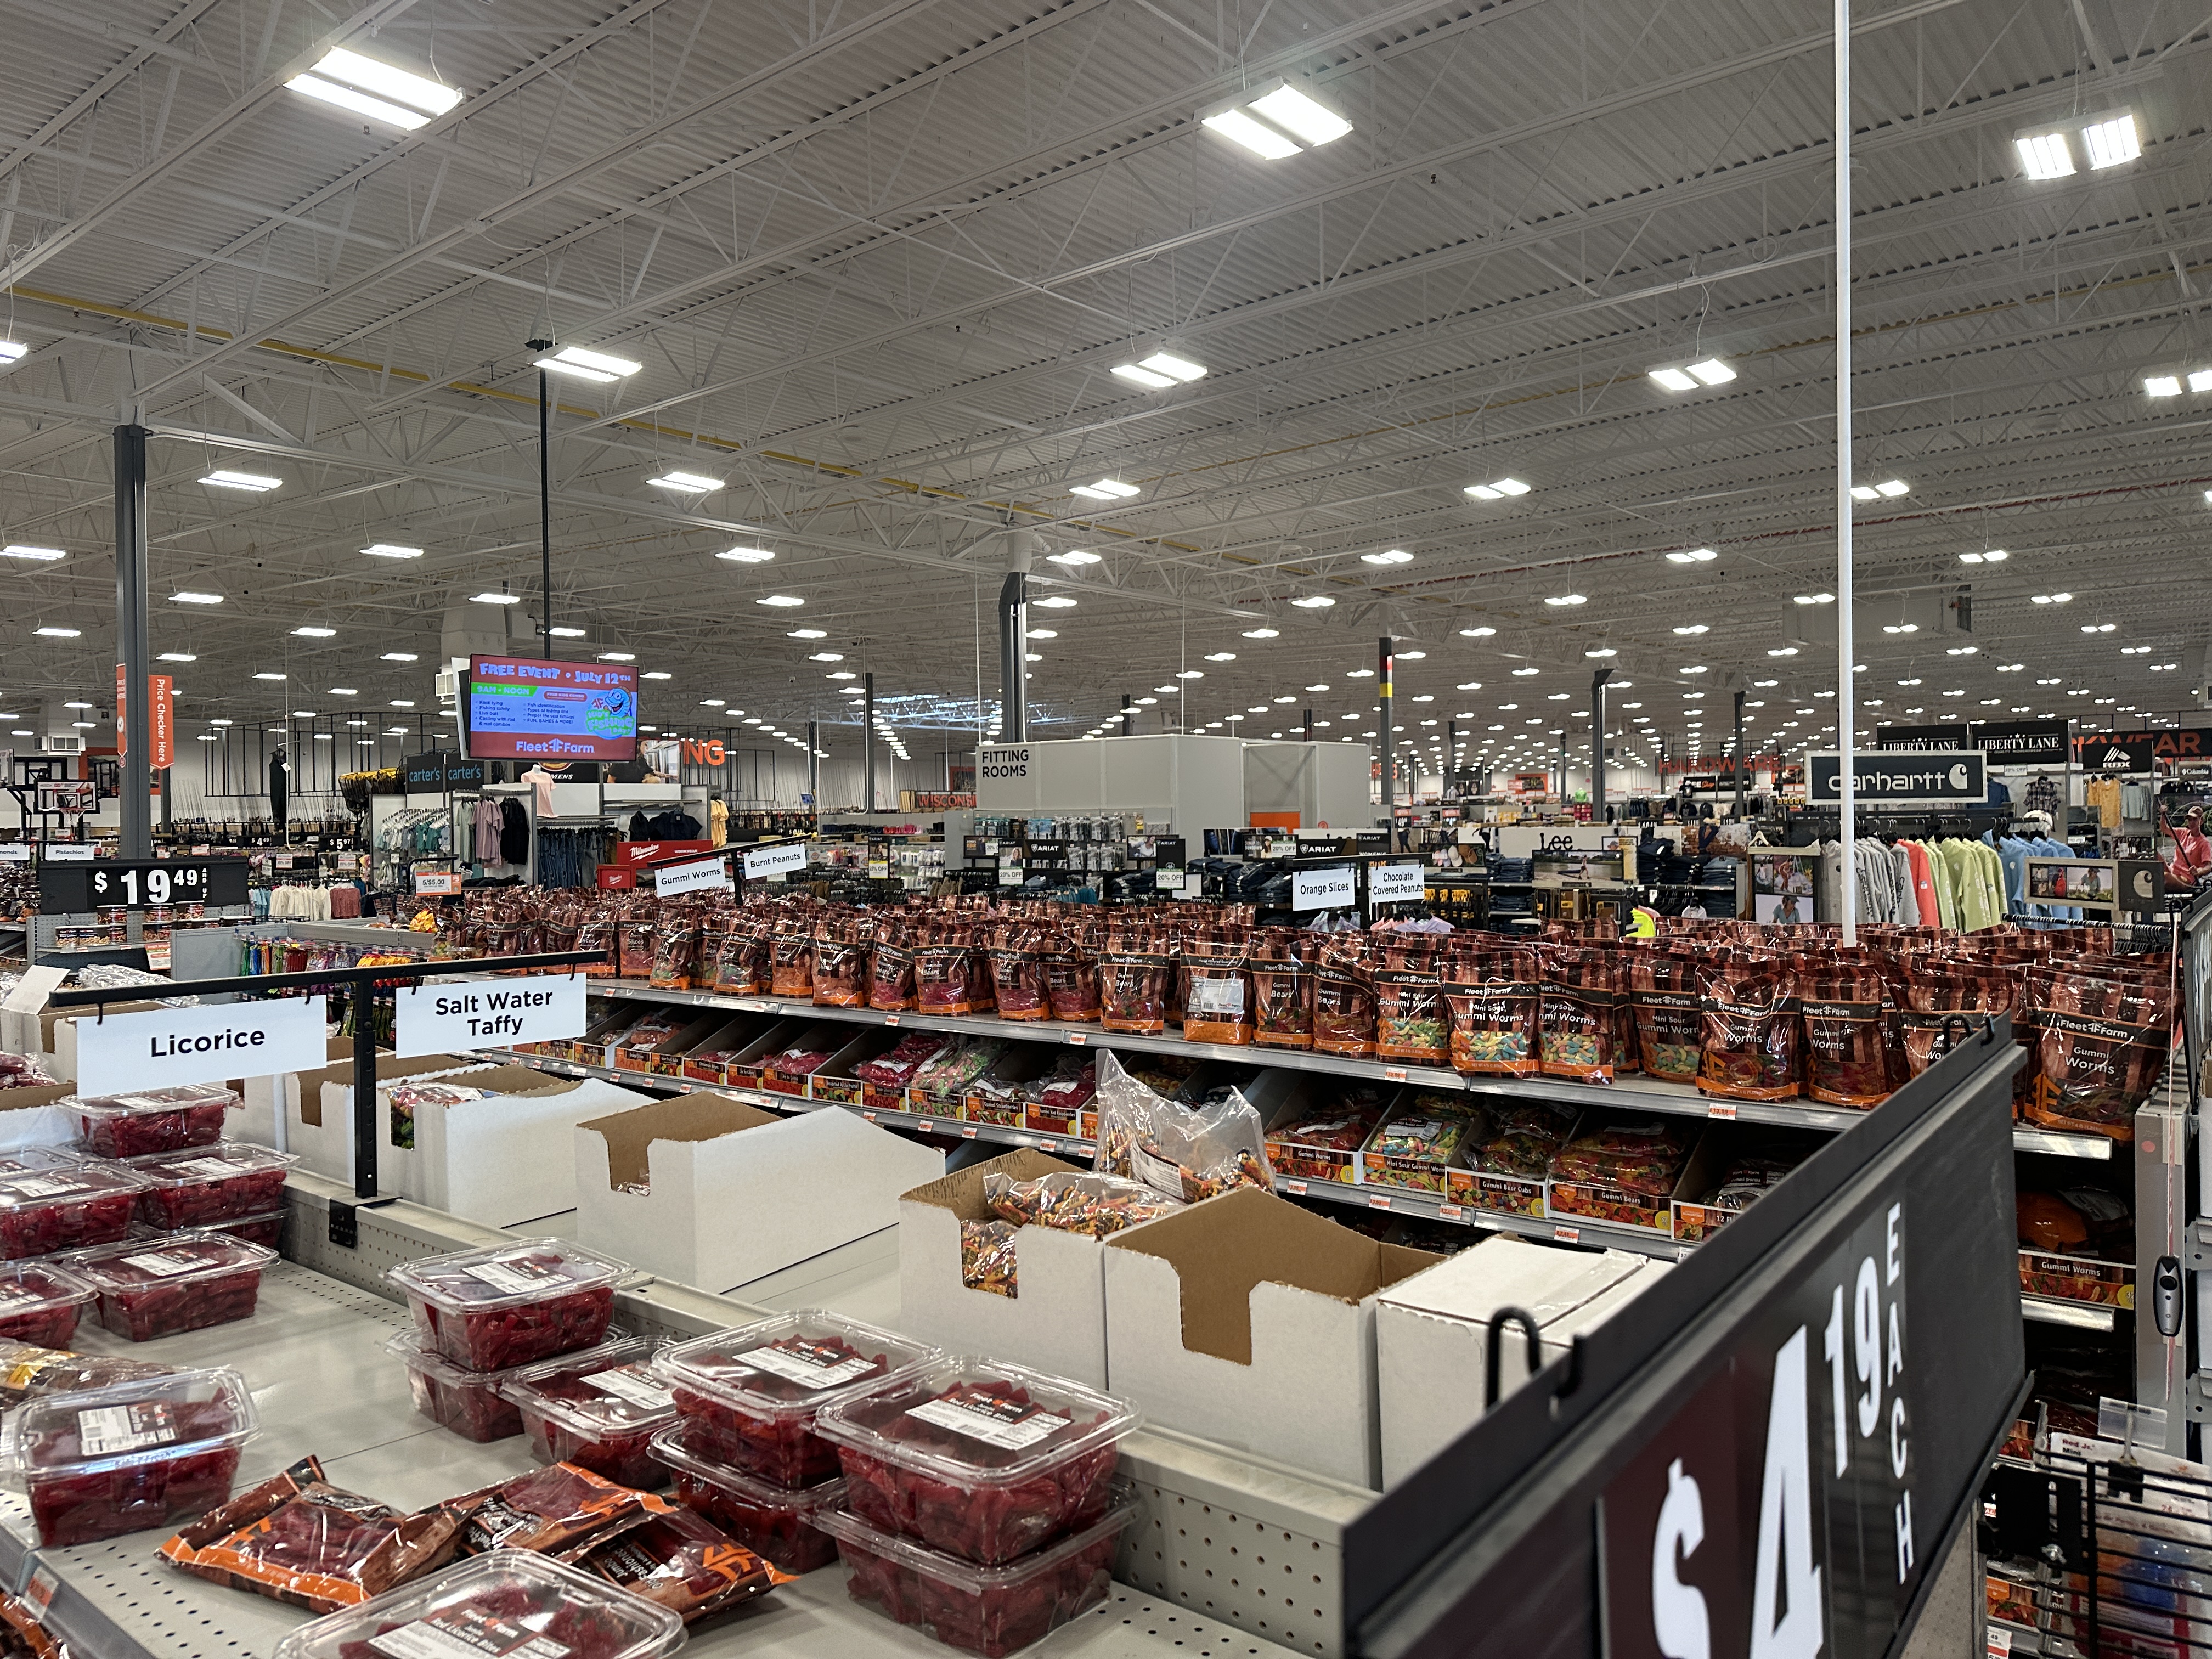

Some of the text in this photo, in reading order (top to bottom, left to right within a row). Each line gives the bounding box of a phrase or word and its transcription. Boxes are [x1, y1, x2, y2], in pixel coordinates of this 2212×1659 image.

[479, 663, 515, 675] FREE
[518, 665, 560, 679] EVENT
[574, 670, 603, 684] JULY
[504, 687, 529, 695] NOON
[156, 679, 166, 762] Price Checker Here
[587, 719, 634, 732] FISHING
[516, 741, 594, 753] Fleet Farm
[1930, 741, 1959, 751] LANE
[1978, 736, 2059, 751] LIBERTY LANE
[982, 749, 1030, 764] FITTING
[982, 764, 1026, 778] ROOMS
[1658, 755, 1782, 774] HARDWARE
[409, 766, 441, 782] carter's
[448, 764, 481, 781] carter's
[917, 794, 977, 808] WISCONSI
[1539, 832, 1573, 851] Lee
[629, 844, 659, 857] Milwaukee
[751, 853, 800, 868] Burnt Peanuts
[422, 878, 445, 887] 5/$5.00
[661, 868, 720, 886] Gummi Worms
[1383, 872, 1413, 882] Chocolate
[1300, 881, 1349, 896] Orange Slices
[1373, 883, 1424, 896] Covered Peanuts
[1335, 973, 1352, 981] Farm
[1271, 990, 1292, 998] Bears
[1318, 988, 1341, 997] Gummi
[435, 990, 554, 1016] Salt Water
[1317, 996, 1341, 1006] Bears
[1379, 997, 1444, 1009] Gummi Worms
[1643, 996, 1662, 1004] Fleet
[1559, 1003, 1576, 1012] Sour
[1718, 1002, 1769, 1017] Fleet Farm
[1803, 1005, 1850, 1015] Fleet Farm
[1454, 1011, 1524, 1023] Gummi Worms
[1559, 1012, 1596, 1026] Worms
[467, 1015, 523, 1037] Taffy
[1637, 1021, 1668, 1034] Gummi
[1730, 1023, 1758, 1032] Gummi
[1813, 1028, 1839, 1037] Gummi
[2059, 1019, 2128, 1039] Fleet Farm
[149, 1027, 266, 1058] Licorice
[1724, 1032, 1763, 1043] Worms
[1810, 1039, 1845, 1051] Worms
[2073, 1047, 2109, 1059] Gummi
[2065, 1056, 2114, 1074] Worms
[1297, 1150, 1314, 1159] Gummi
[1398, 1161, 1410, 1169] Sour
[1412, 1163, 1430, 1171] Gummi
[1482, 1181, 1532, 1194] Gummi Bear Cubs
[1601, 1192, 1640, 1204] Gummi Bears
[1717, 1215, 1724, 1223] 12
[2041, 1261, 2101, 1277] Gummi Worms
[1887, 1202, 1914, 1585] EACH
[970, 1392, 1023, 1413] Fleet Farm
[2062, 1438, 2080, 1448] Red
[605, 1557, 628, 1578] Jumbo
